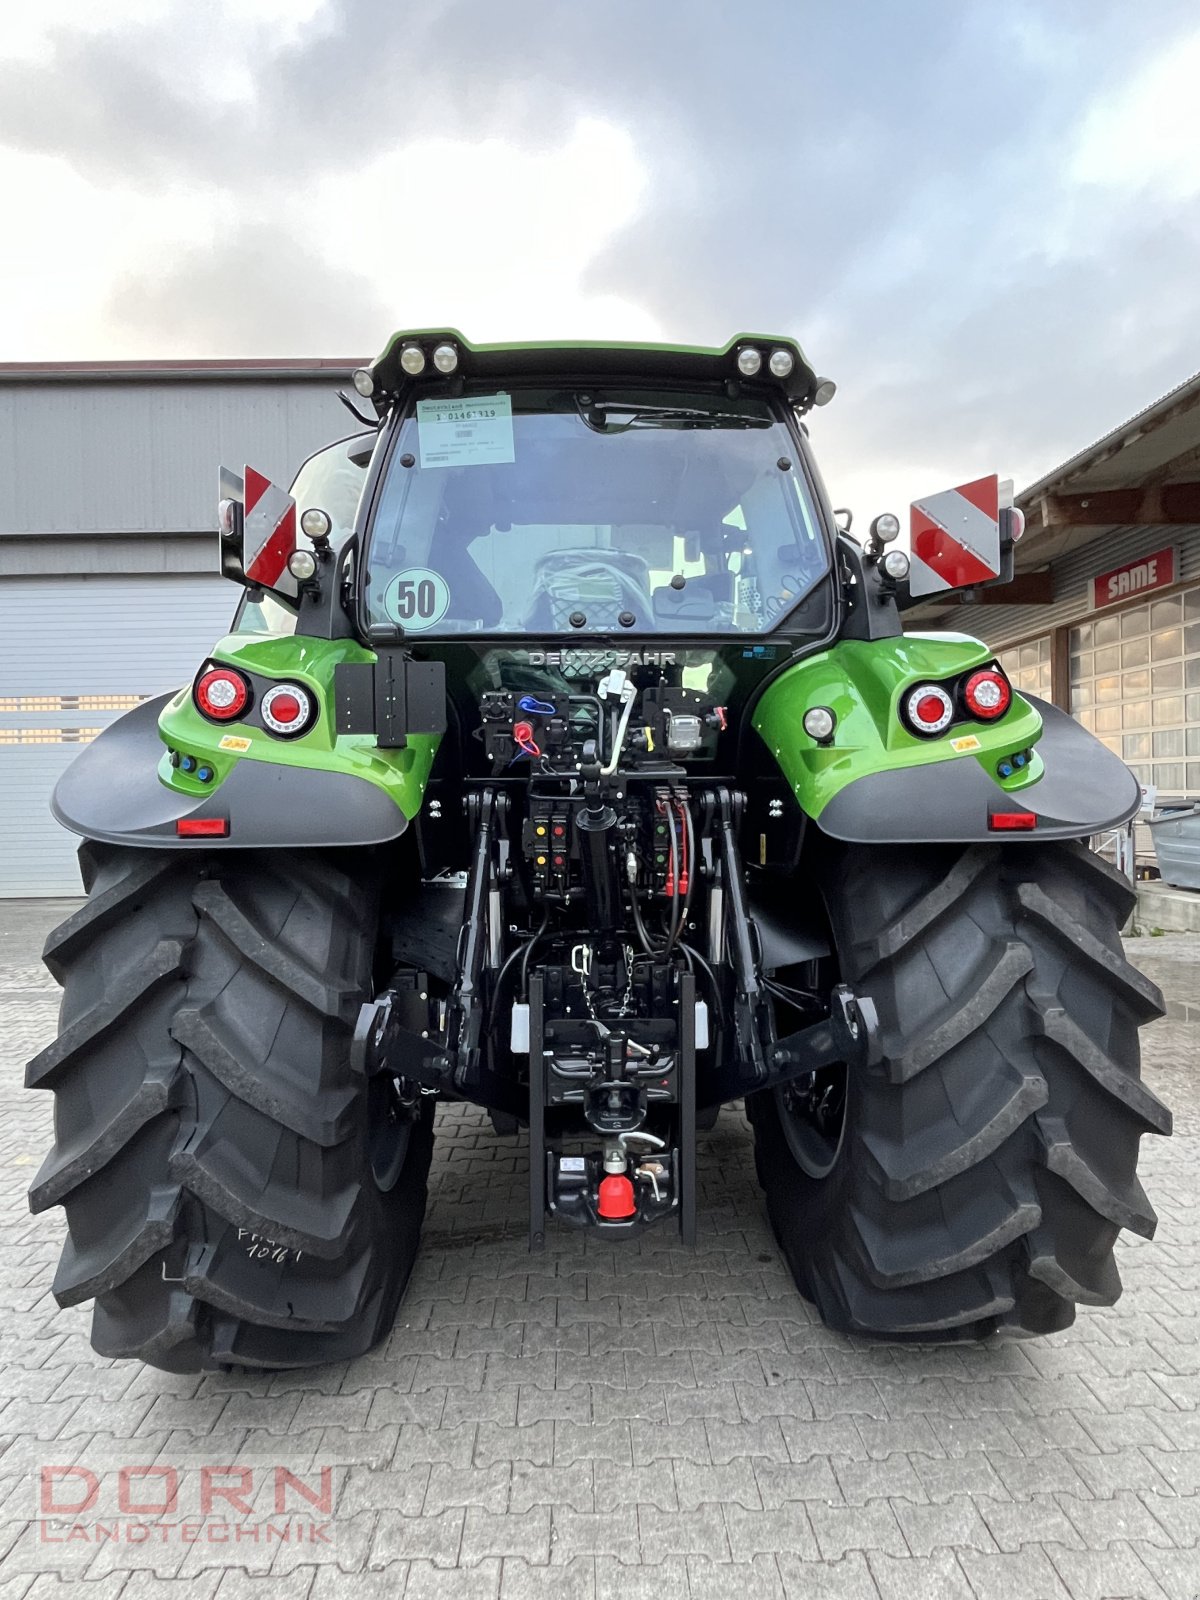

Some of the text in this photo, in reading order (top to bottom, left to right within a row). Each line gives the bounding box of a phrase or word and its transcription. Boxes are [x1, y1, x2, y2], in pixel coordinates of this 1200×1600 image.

[397, 579, 436, 620] 50
[1108, 559, 1158, 600] SAME
[528, 652, 676, 666] DEUTZ-FAHR
